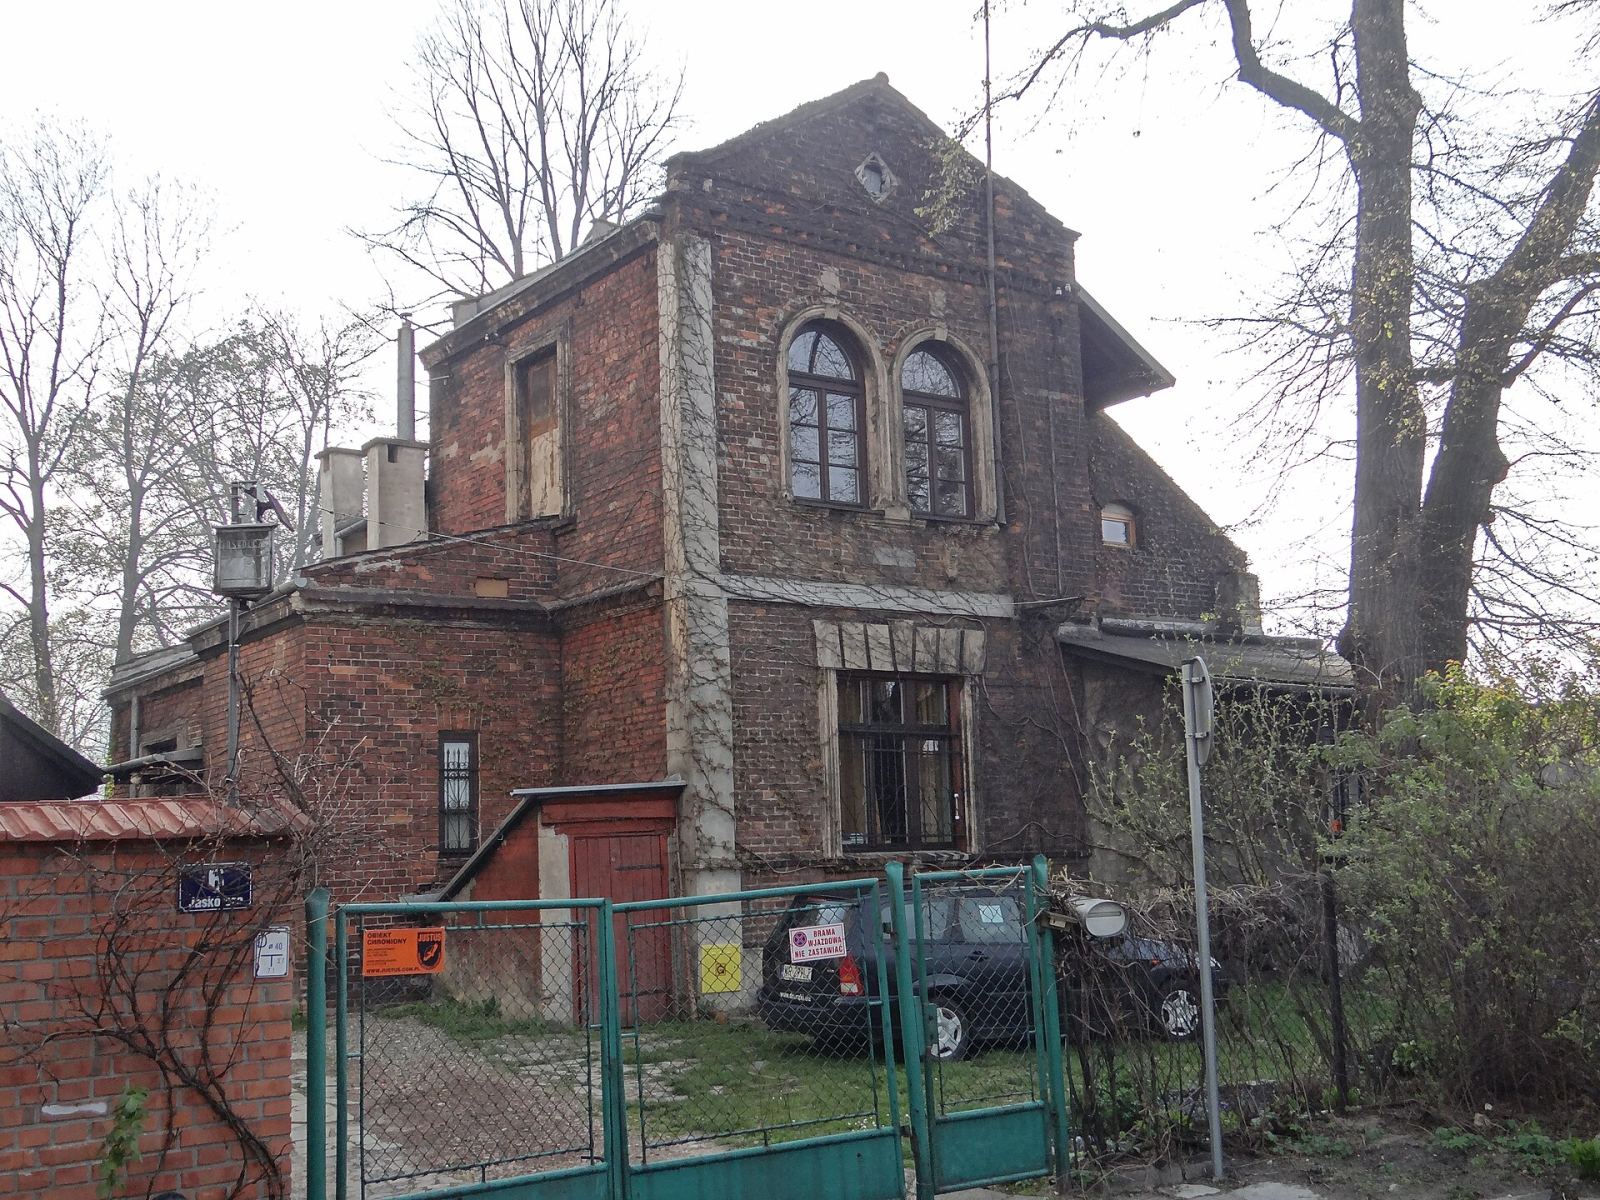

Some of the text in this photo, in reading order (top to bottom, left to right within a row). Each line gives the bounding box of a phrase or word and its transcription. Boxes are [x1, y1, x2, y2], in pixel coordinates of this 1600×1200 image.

[418, 933, 442, 942] JUSTUS
[813, 928, 836, 938] BRAMA
[808, 937, 842, 947] WJAZDOWA
[794, 950, 806, 958] NIE
